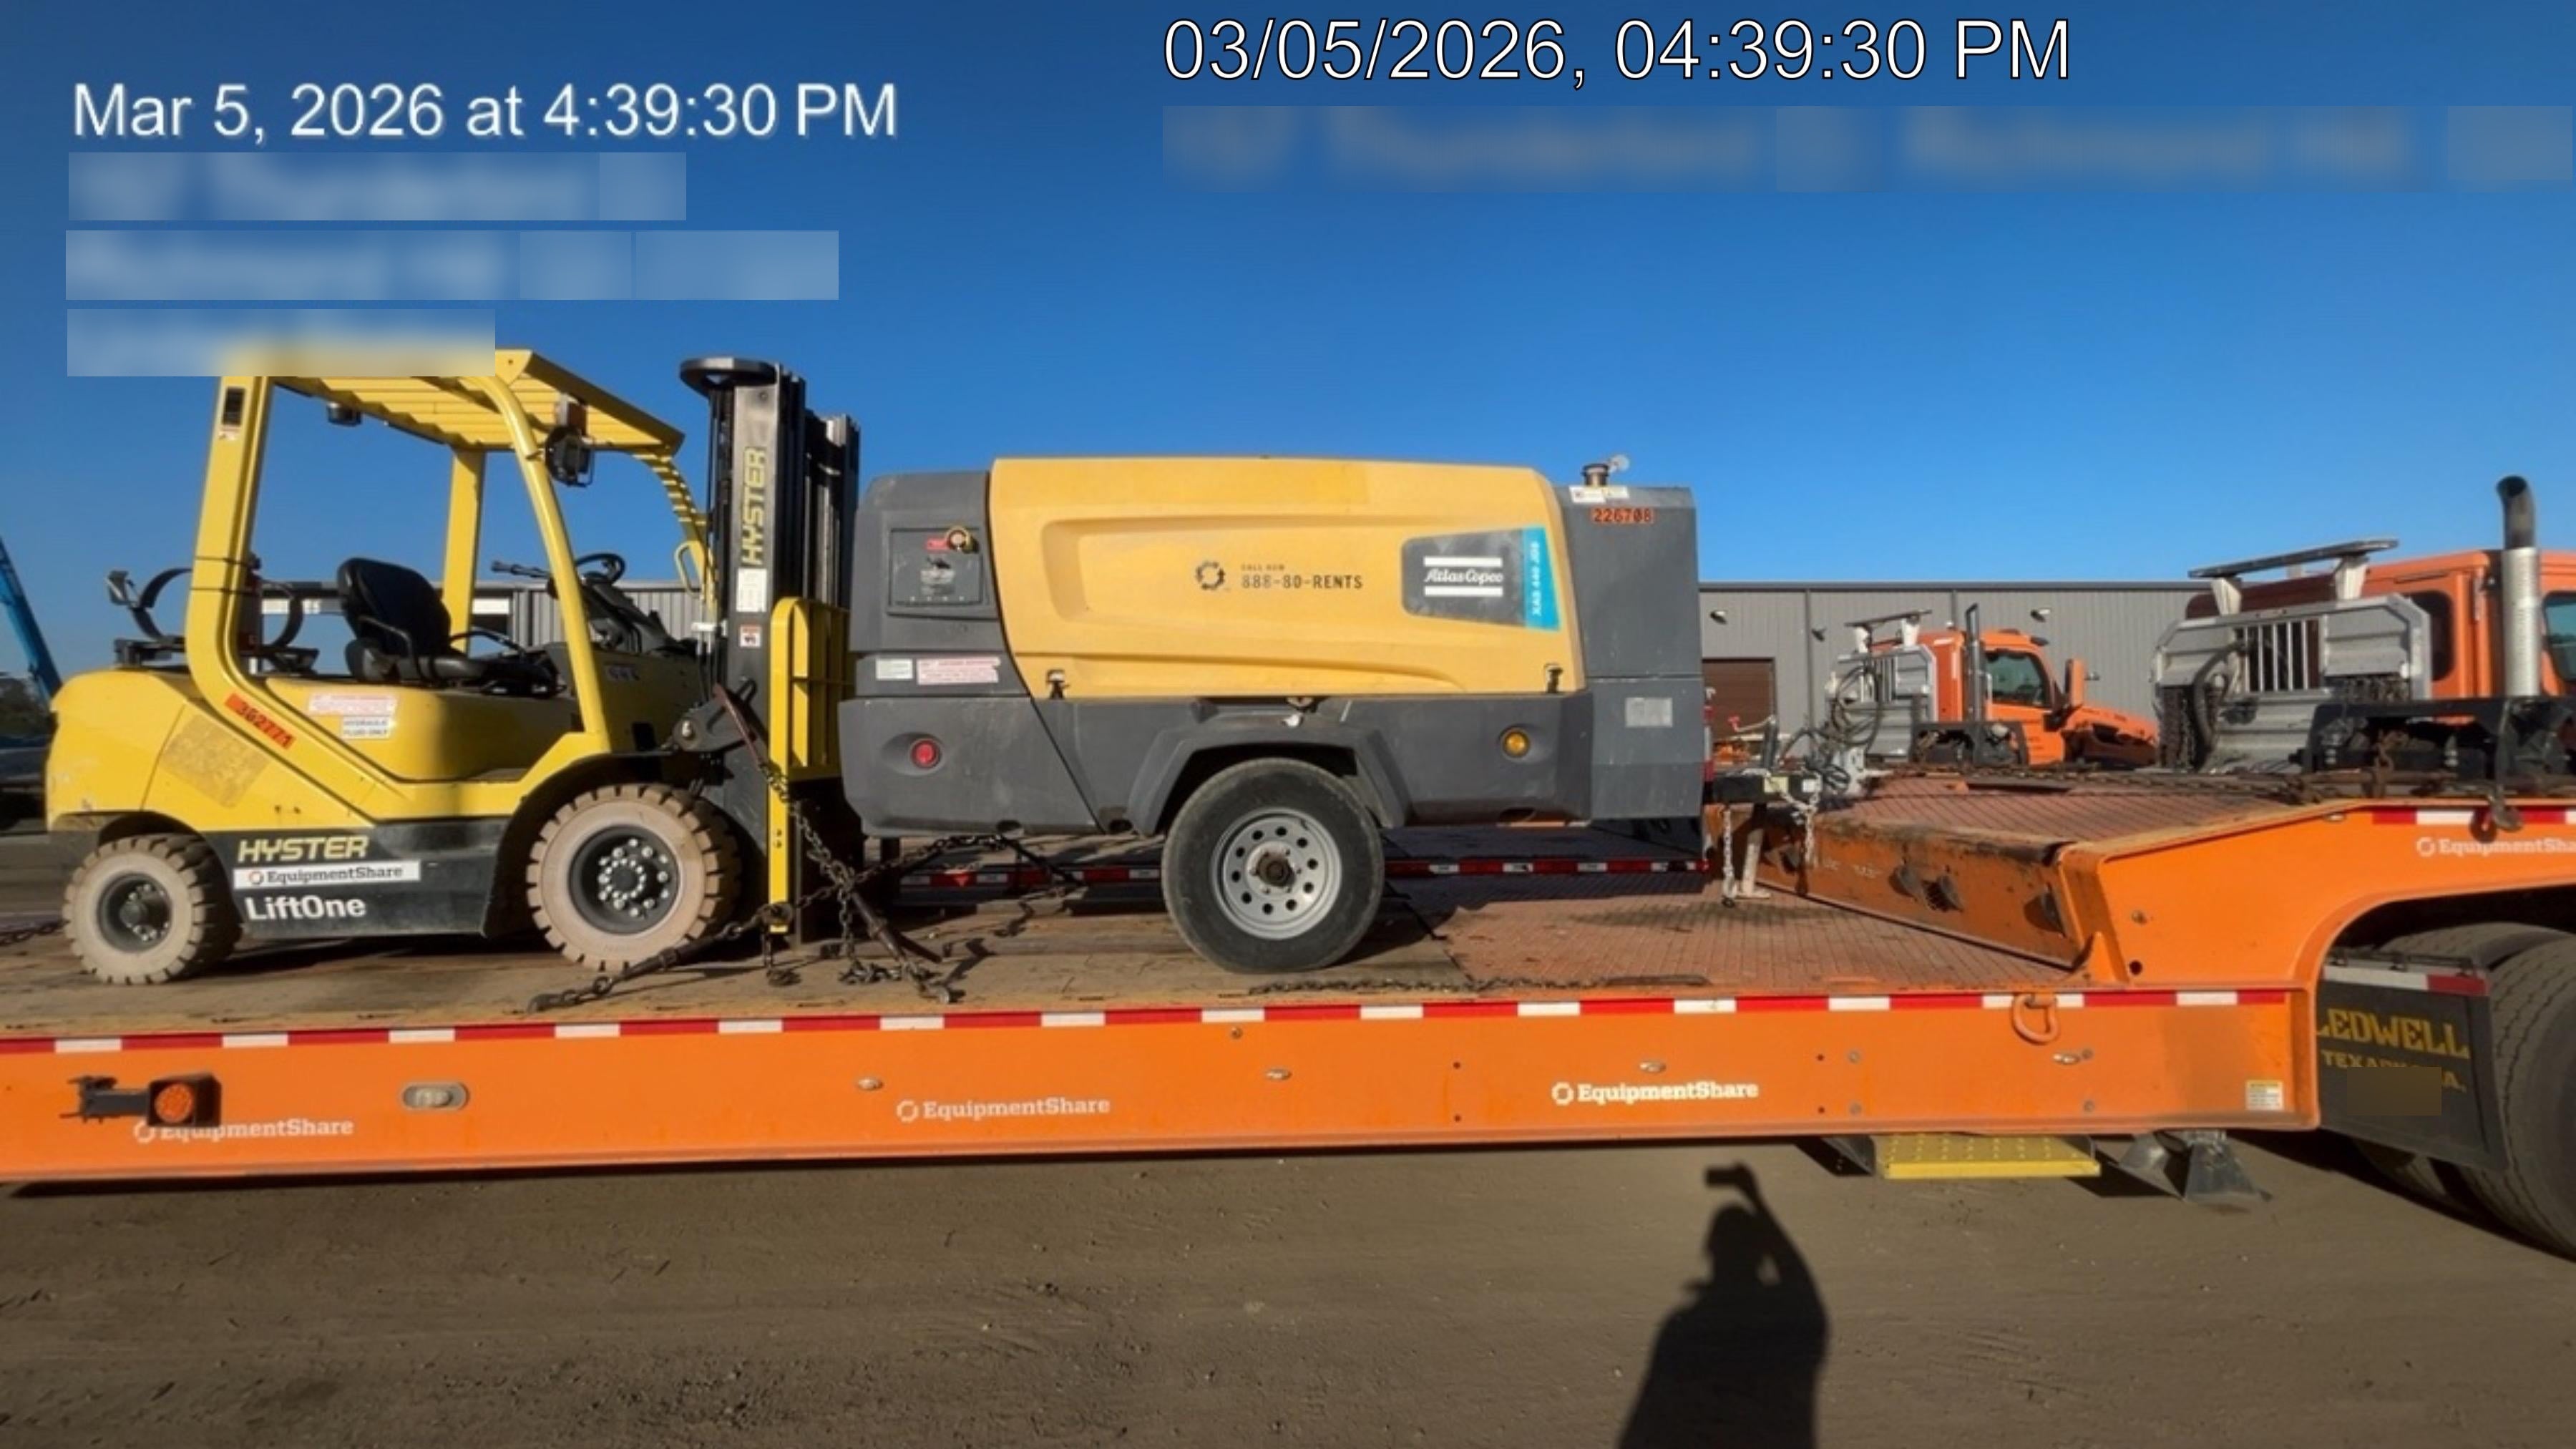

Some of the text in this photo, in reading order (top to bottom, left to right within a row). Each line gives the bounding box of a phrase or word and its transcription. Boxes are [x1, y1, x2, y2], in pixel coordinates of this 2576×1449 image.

[742, 446, 766, 565] HYSTER
[1594, 507, 1652, 522] 226708
[1241, 575, 1363, 589] 888-80-RENTS
[1424, 569, 1503, 585] Atlas Copco
[238, 836, 369, 863] HYSTER
[267, 867, 403, 884] EquipmentShare
[244, 895, 366, 920] LiftOne
[1577, 1082, 1759, 1104] EquipmentShare
[922, 1097, 1111, 1121] EquipmentShare
